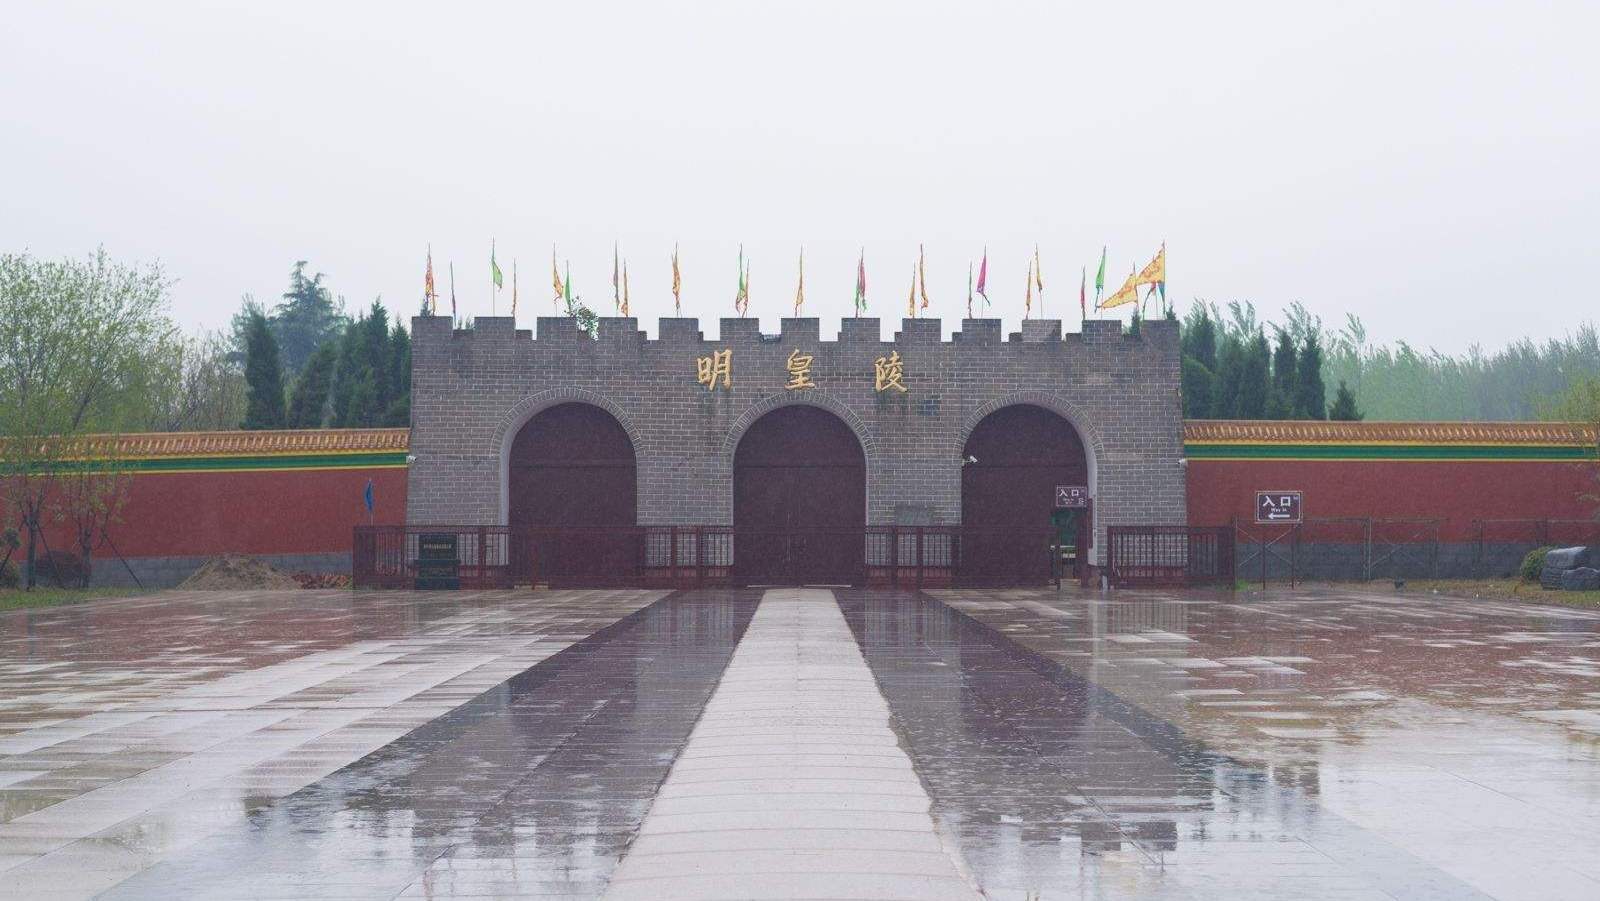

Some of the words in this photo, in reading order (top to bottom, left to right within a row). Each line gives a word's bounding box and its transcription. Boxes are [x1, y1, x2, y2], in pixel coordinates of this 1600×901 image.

[696, 349, 908, 393] 明皇陵
[1059, 489, 1079, 497] 入口
[1262, 495, 1291, 507] 入口
